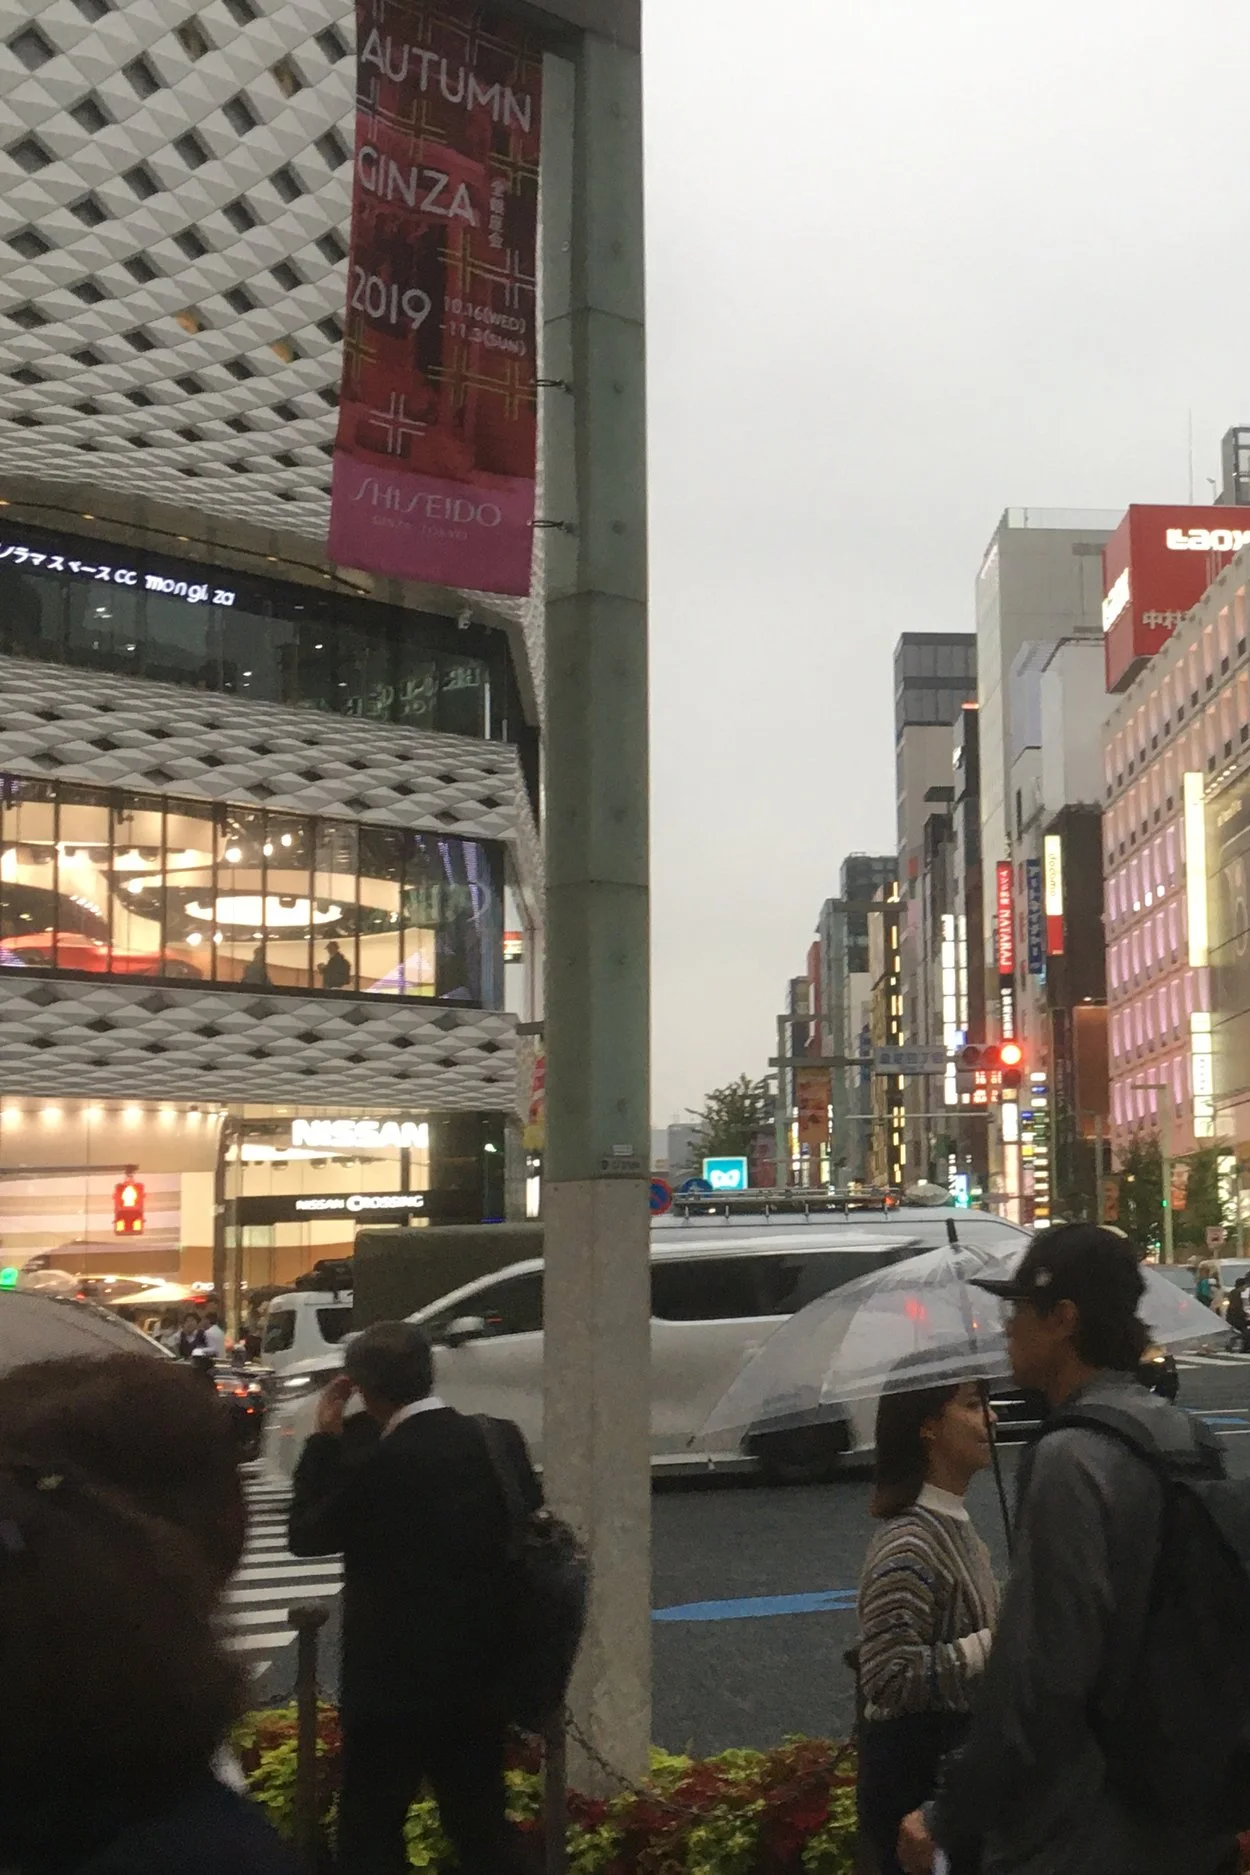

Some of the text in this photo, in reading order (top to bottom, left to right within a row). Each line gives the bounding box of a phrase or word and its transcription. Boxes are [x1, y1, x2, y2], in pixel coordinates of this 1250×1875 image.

[361, 27, 531, 132] AUTUMN
[357, 146, 480, 227] GINZA
[350, 265, 431, 329] 2019
[354, 477, 502, 527] SHISEIDO
[999, 909, 1012, 966] NATARAJ
[291, 1119, 429, 1149] NISSAN
